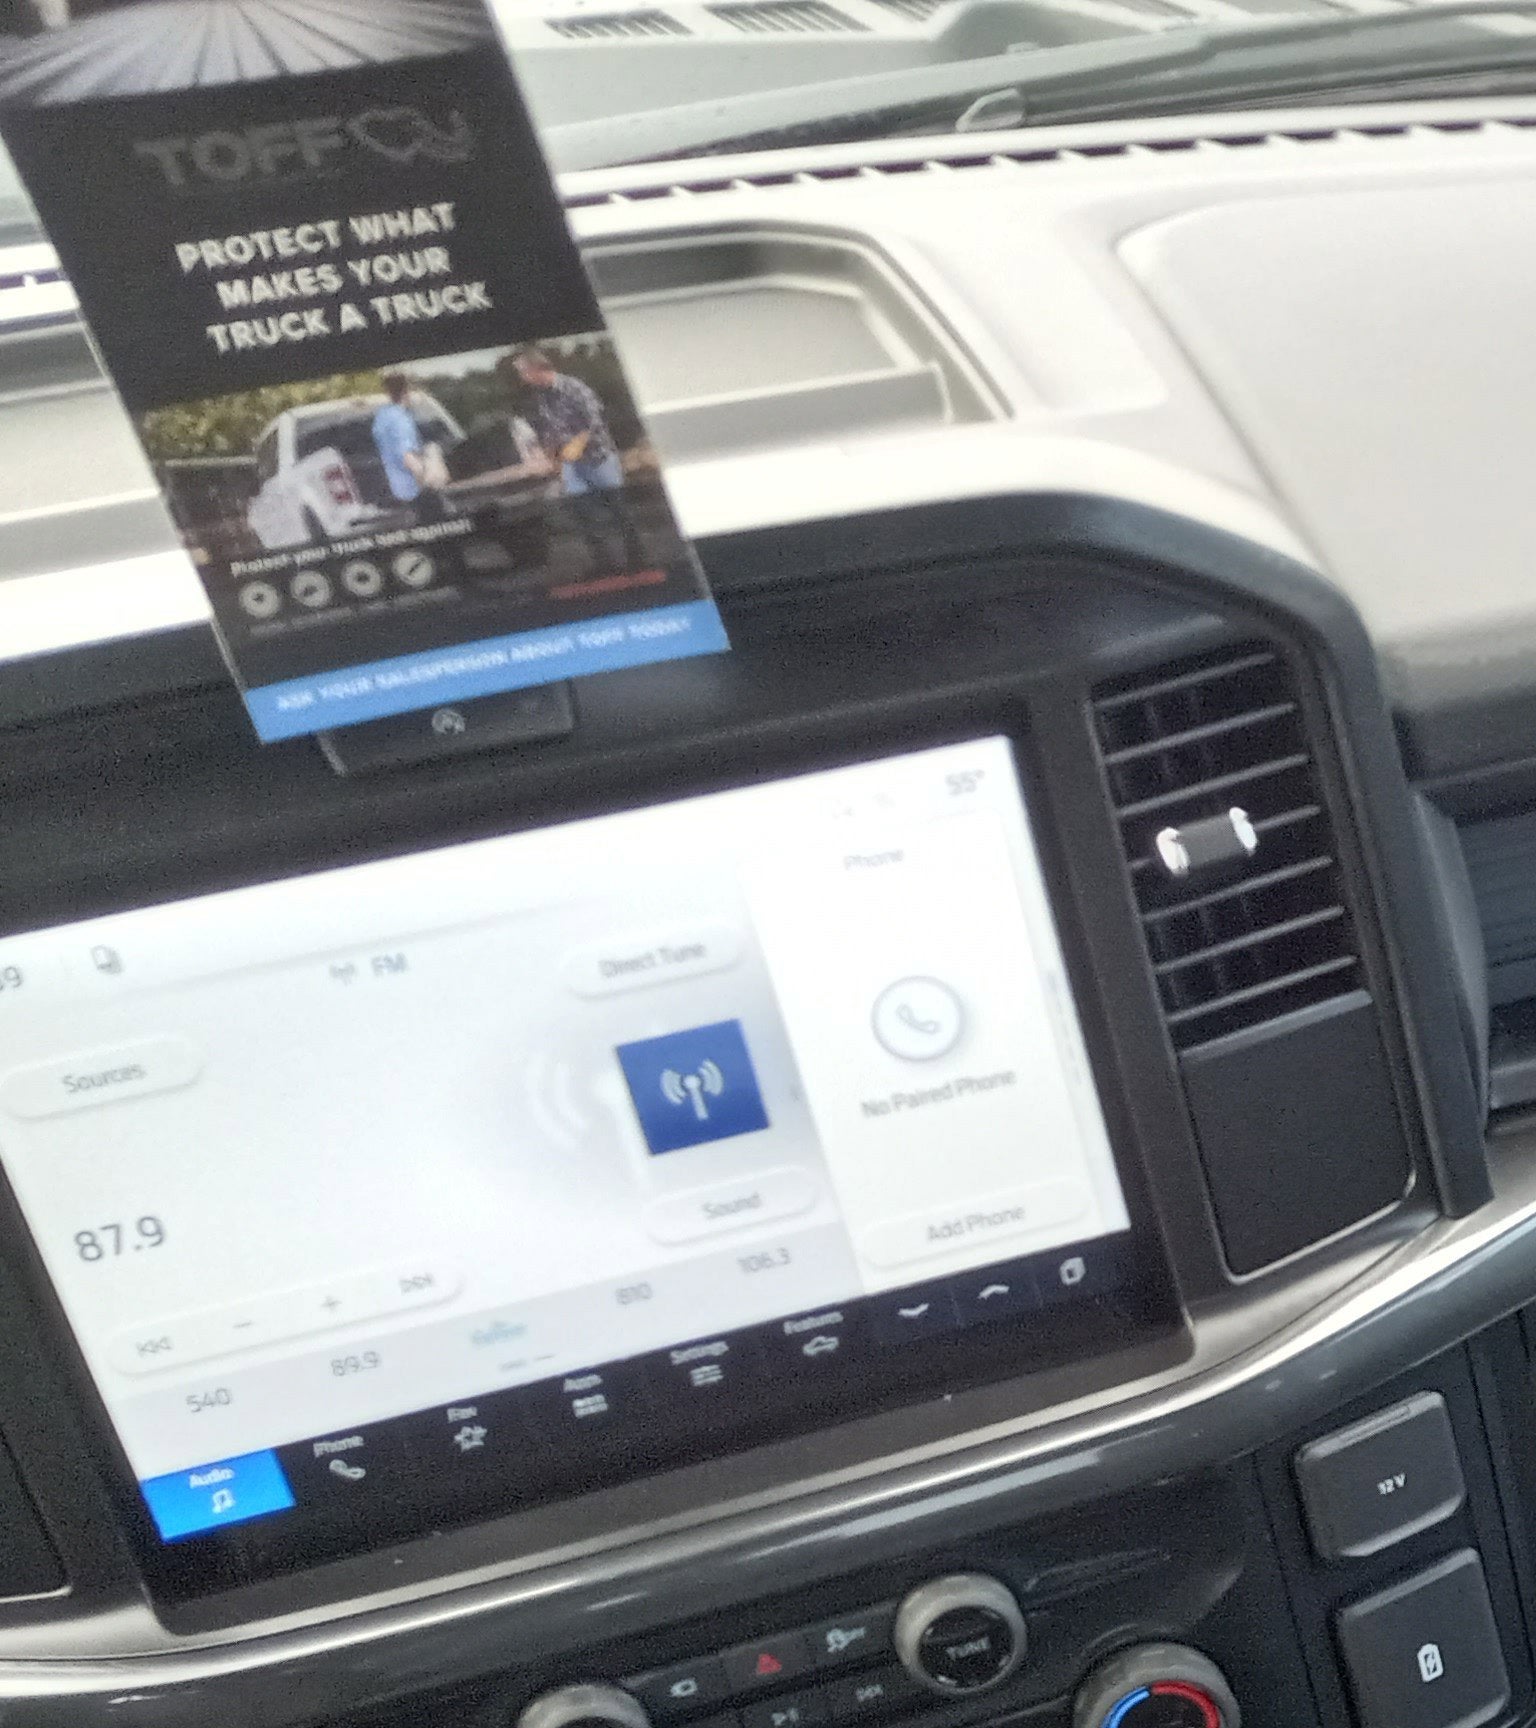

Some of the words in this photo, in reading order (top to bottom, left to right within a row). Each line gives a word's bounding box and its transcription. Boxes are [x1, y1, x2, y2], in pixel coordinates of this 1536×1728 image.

[175, 219, 342, 274] PROTECT
[348, 201, 456, 246] WHAT
[215, 262, 345, 310] MAKES
[347, 246, 452, 287] YOUR
[206, 306, 330, 353] TRUCK
[339, 302, 368, 334] A
[370, 281, 494, 326] TRUCK
[371, 952, 408, 979] FM
[599, 948, 657, 979] Direct
[662, 940, 706, 969] Tune
[62, 1061, 146, 1095] Sources
[861, 1097, 888, 1119] No
[893, 1082, 954, 1113] Paired
[956, 1066, 1017, 1099] Phone
[702, 1190, 761, 1220] Sound
[926, 1217, 966, 1243] Add
[968, 1201, 1027, 1234] Phone
[73, 1214, 166, 1263] 87.9
[186, 1386, 233, 1414] 540
